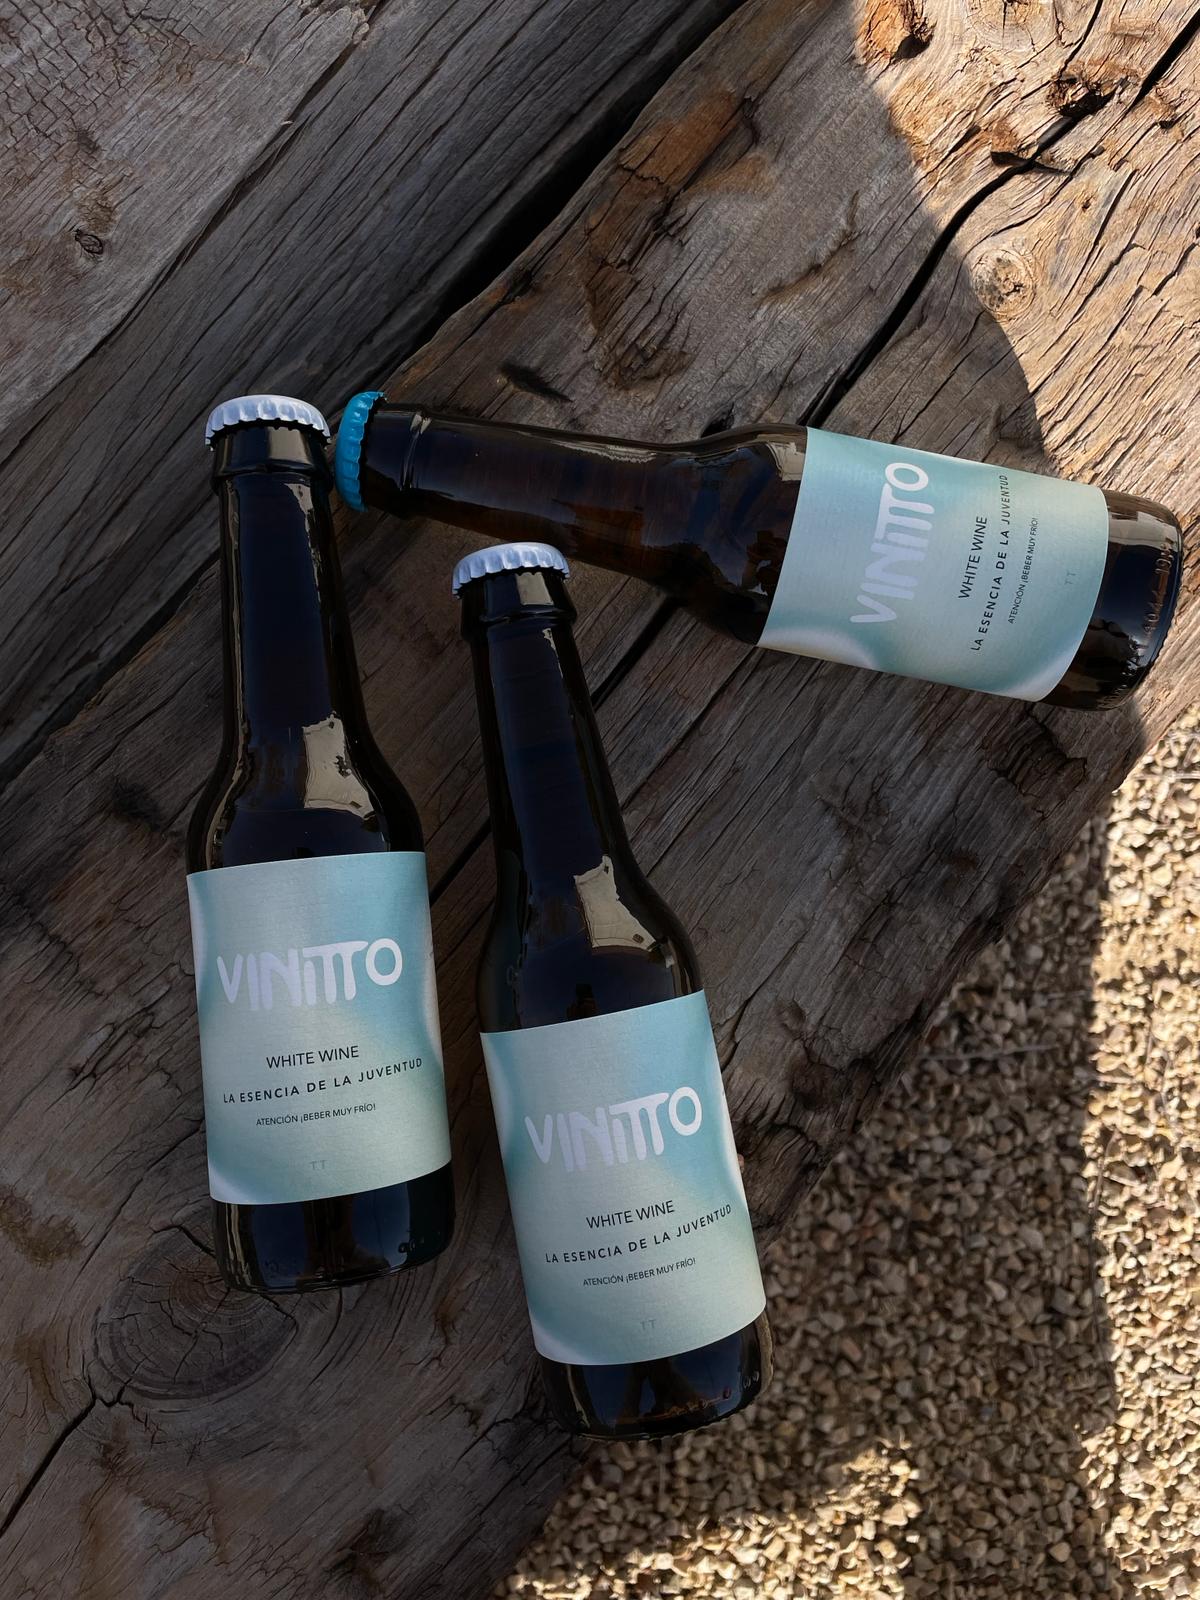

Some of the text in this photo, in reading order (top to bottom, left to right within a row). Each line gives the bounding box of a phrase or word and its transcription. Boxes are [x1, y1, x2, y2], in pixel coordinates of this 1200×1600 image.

[958, 516, 987, 599] WHITE WINE
[971, 475, 1011, 651] LA ESENCIA DE LA JUVENTUD
[1007, 517, 1039, 624] ATENCIÓN ¡BEBER MUY FRÍO!
[266, 1045, 359, 1069] WHITE WINE
[223, 1058, 422, 1104] LA ESENCIA DE LA JUVENTUD
[256, 1103, 376, 1126] ATENCIÓN ¡BEBER MUY FRÍO!
[545, 1204, 732, 1263] LA ESENCIA DE LA JUVENTUD
[586, 1200, 675, 1229] WHITE WINE
[583, 1257, 696, 1287] ATENCIÓN ¡BEBER MUY FRÍO!
